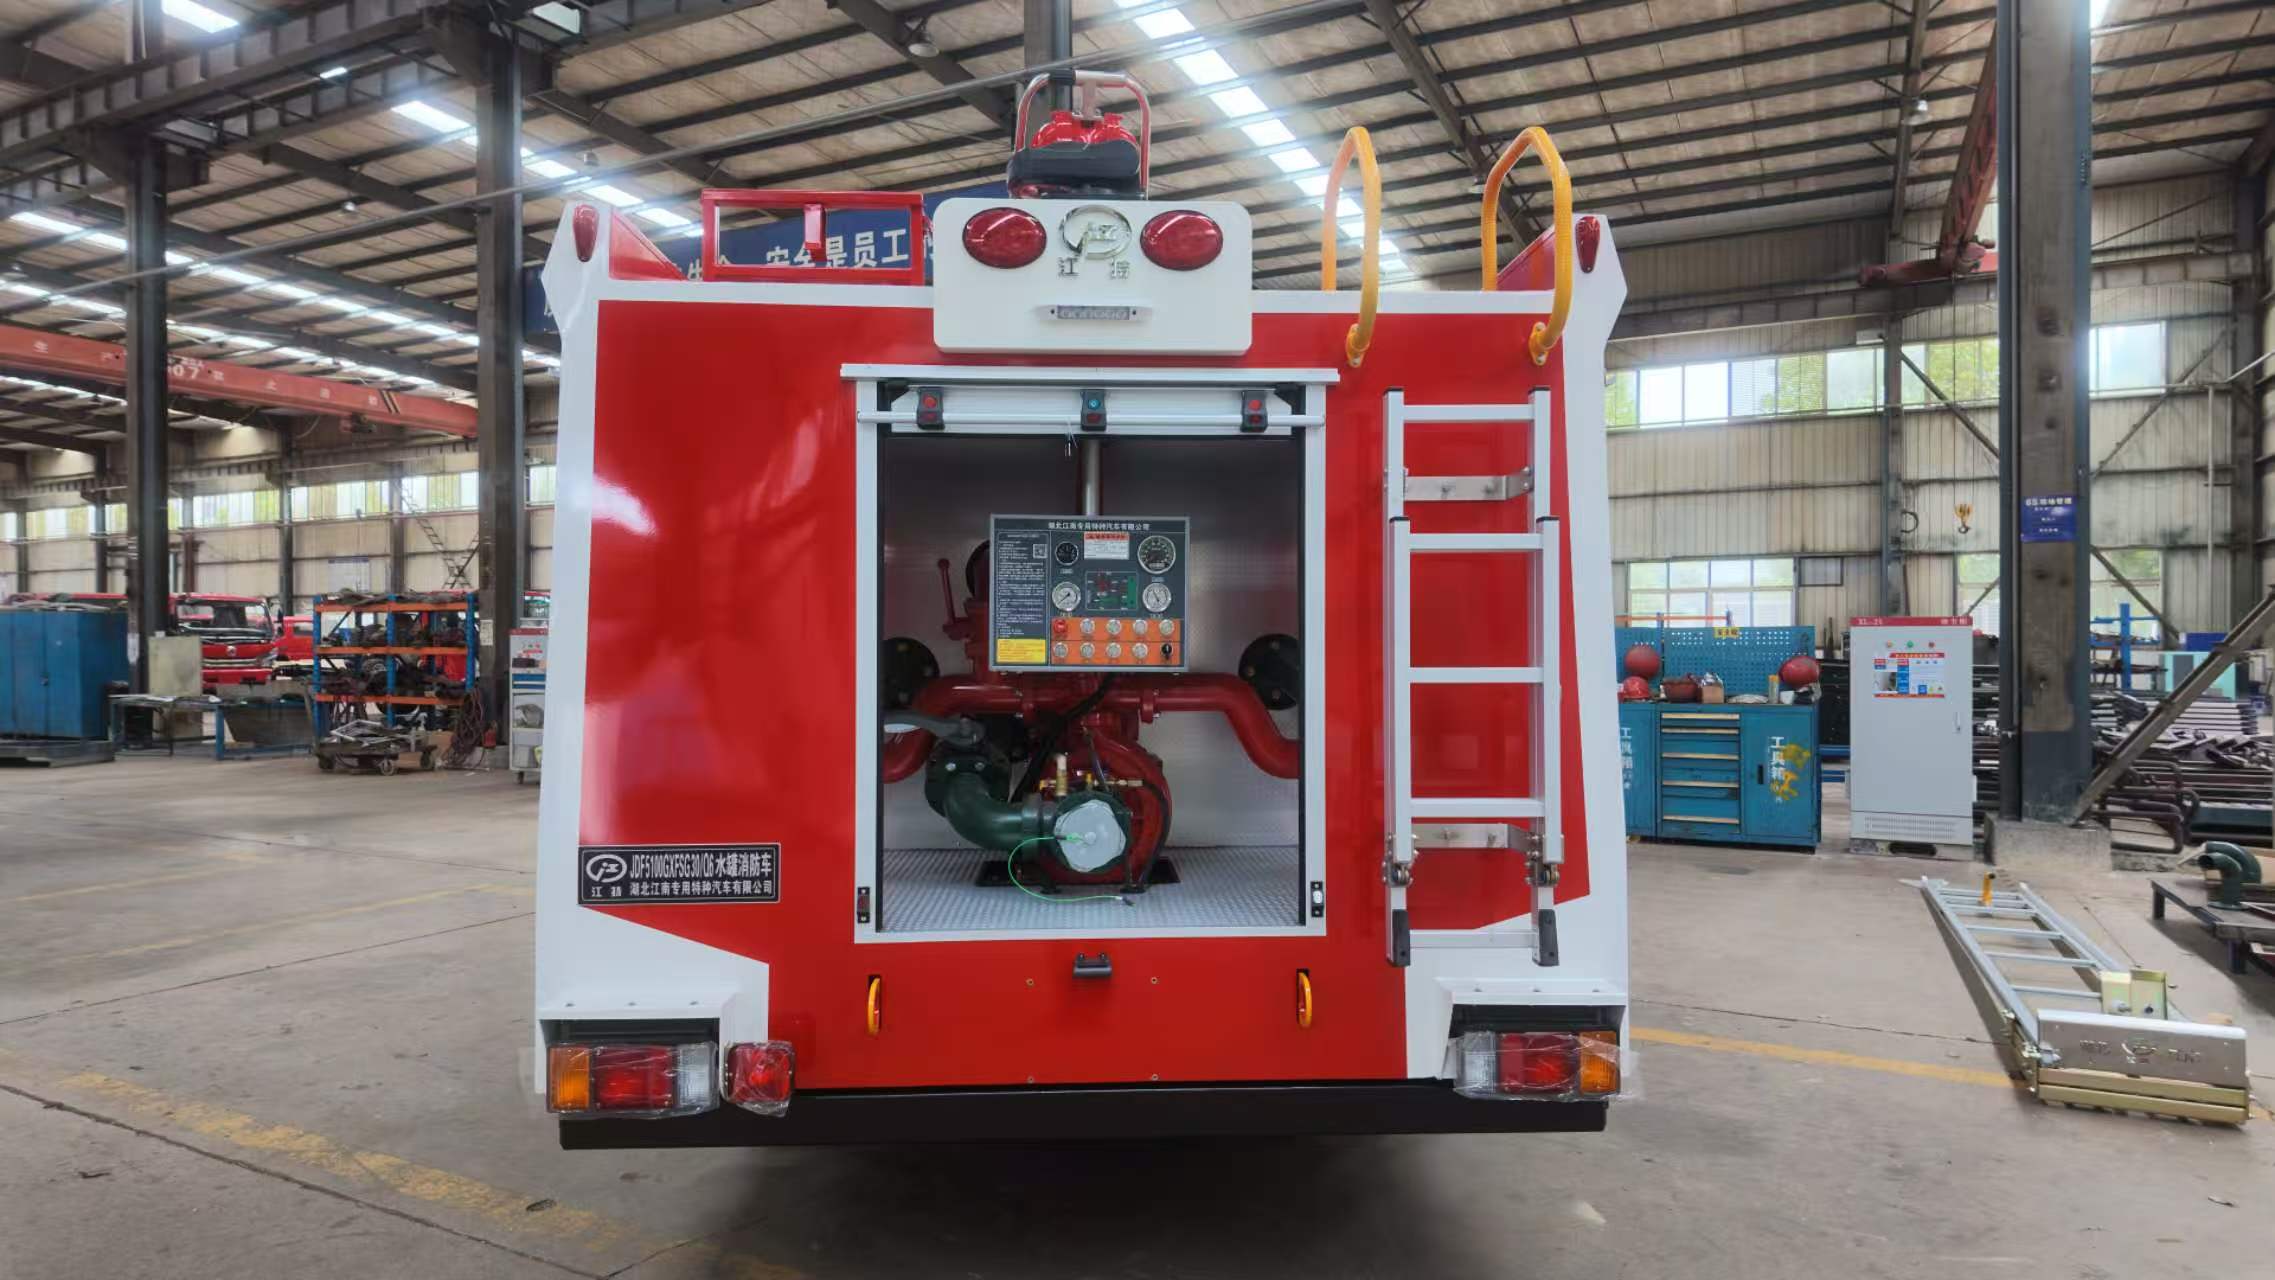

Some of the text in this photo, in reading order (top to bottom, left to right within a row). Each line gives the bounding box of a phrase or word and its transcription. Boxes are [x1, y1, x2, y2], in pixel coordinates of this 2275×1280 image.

[630, 880, 772, 897] 湖北江南专用特种汽车有限公司
